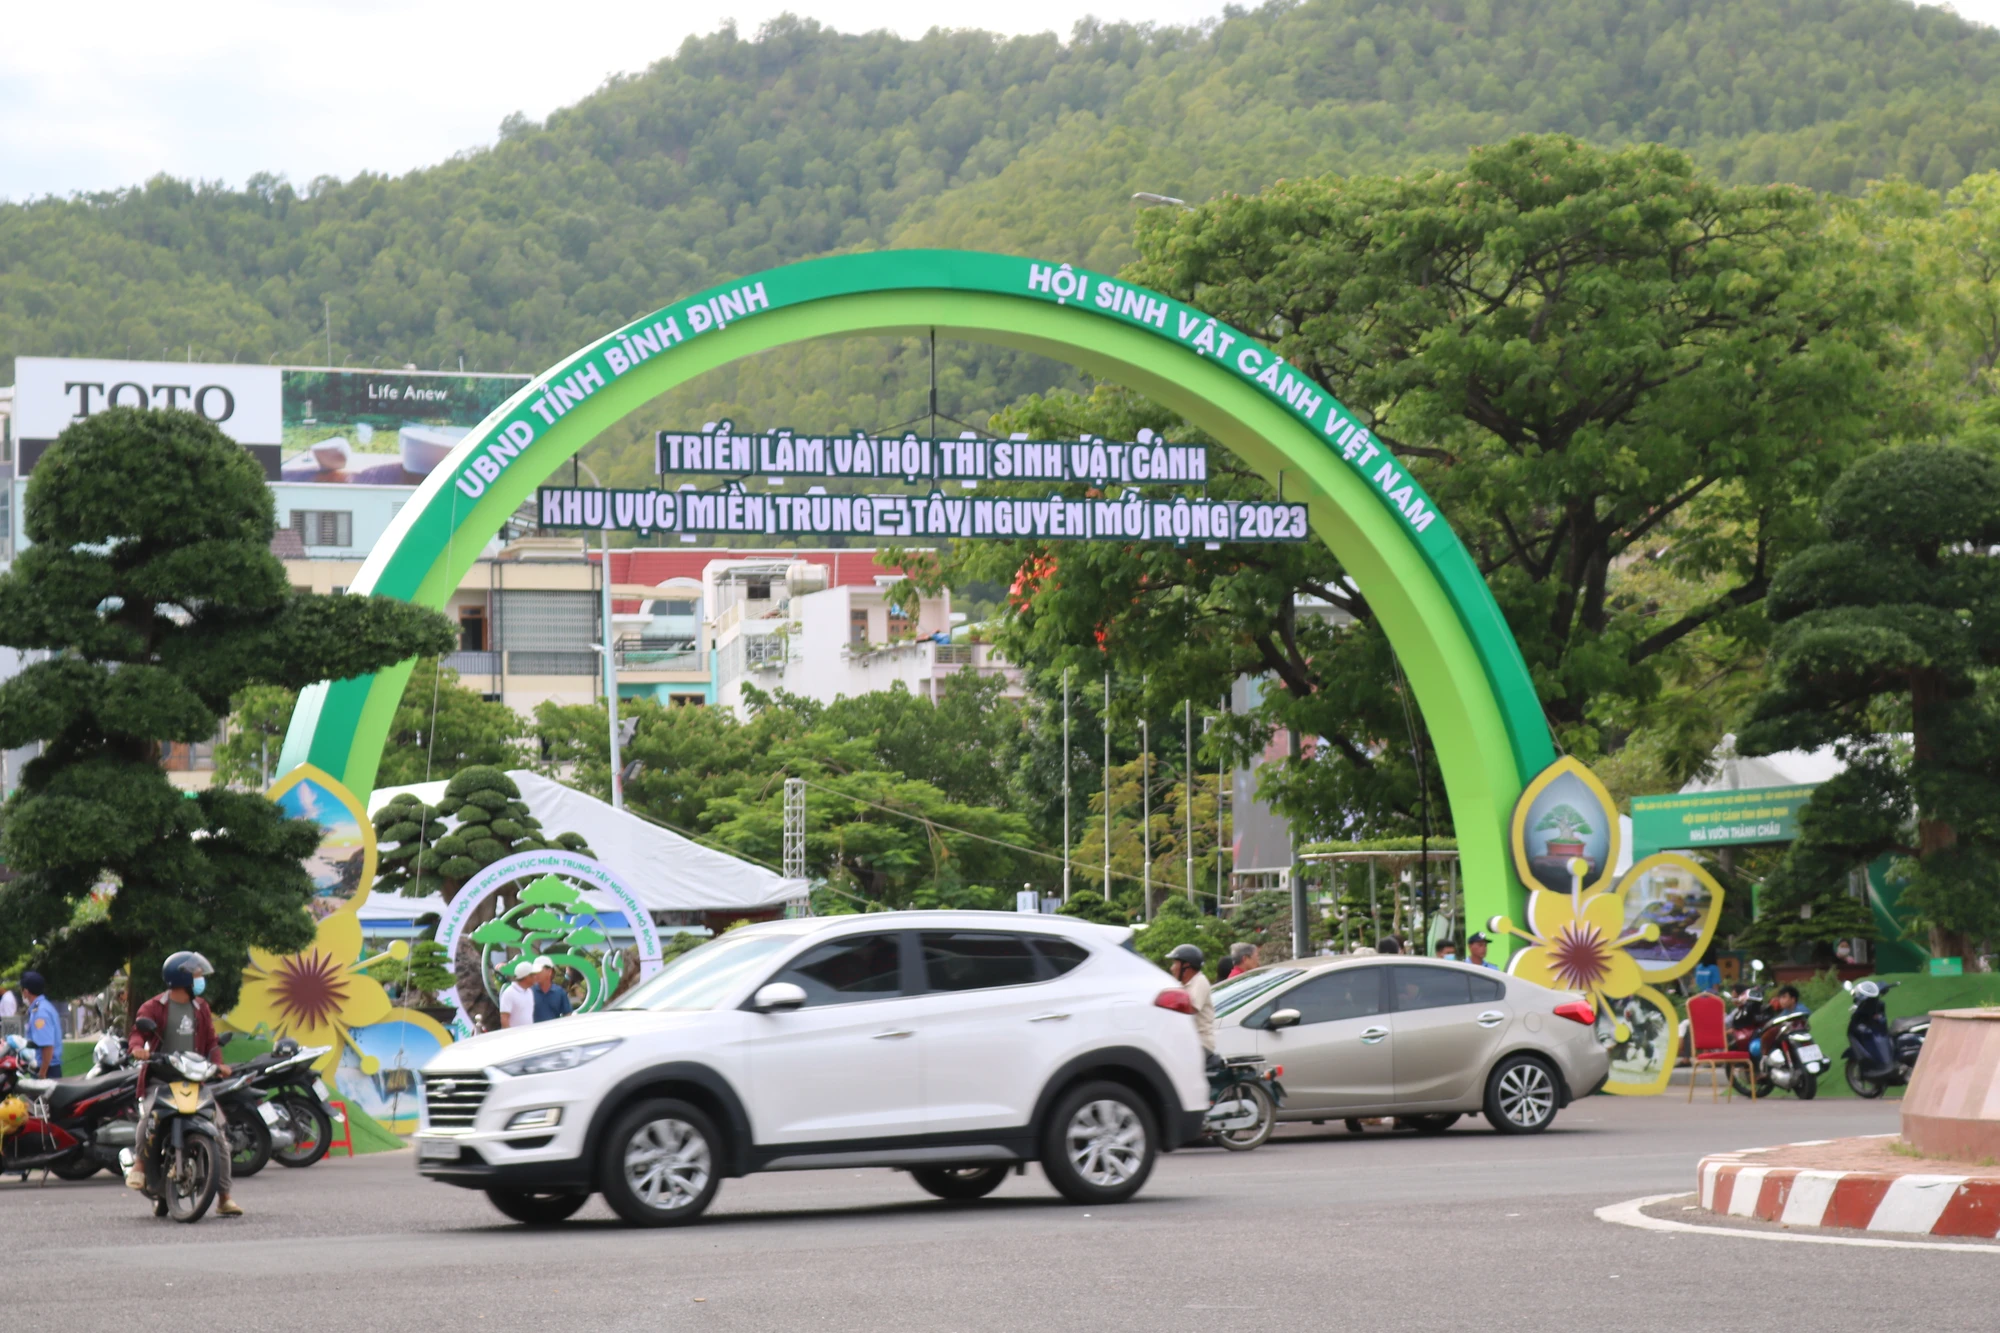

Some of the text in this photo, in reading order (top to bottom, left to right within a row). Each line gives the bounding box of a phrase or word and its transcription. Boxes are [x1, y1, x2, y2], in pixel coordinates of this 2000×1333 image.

[64, 381, 235, 423] TOTO
[368, 383, 448, 400] Life Anew
[455, 281, 769, 498] UBND TỈNH BÌNH ĐỊNH
[1027, 262, 1436, 533] HỘI SINH VẬT CẢNH VIỆT NAM
[665, 420, 1206, 485] TRIỂN LÃM VÀ HỘI THI SINH VẬT CẢNH
[542, 489, 603, 526] KHU
[615, 491, 676, 535] VỰC
[686, 482, 763, 530] MIỀN
[775, 497, 871, 532] TRUNG
[911, 492, 963, 533] TÂY
[974, 495, 1084, 536] NGUYÊN
[1095, 493, 1143, 536] MỞ
[1153, 497, 1229, 544] RỘNG
[1239, 505, 1307, 538] 2023
